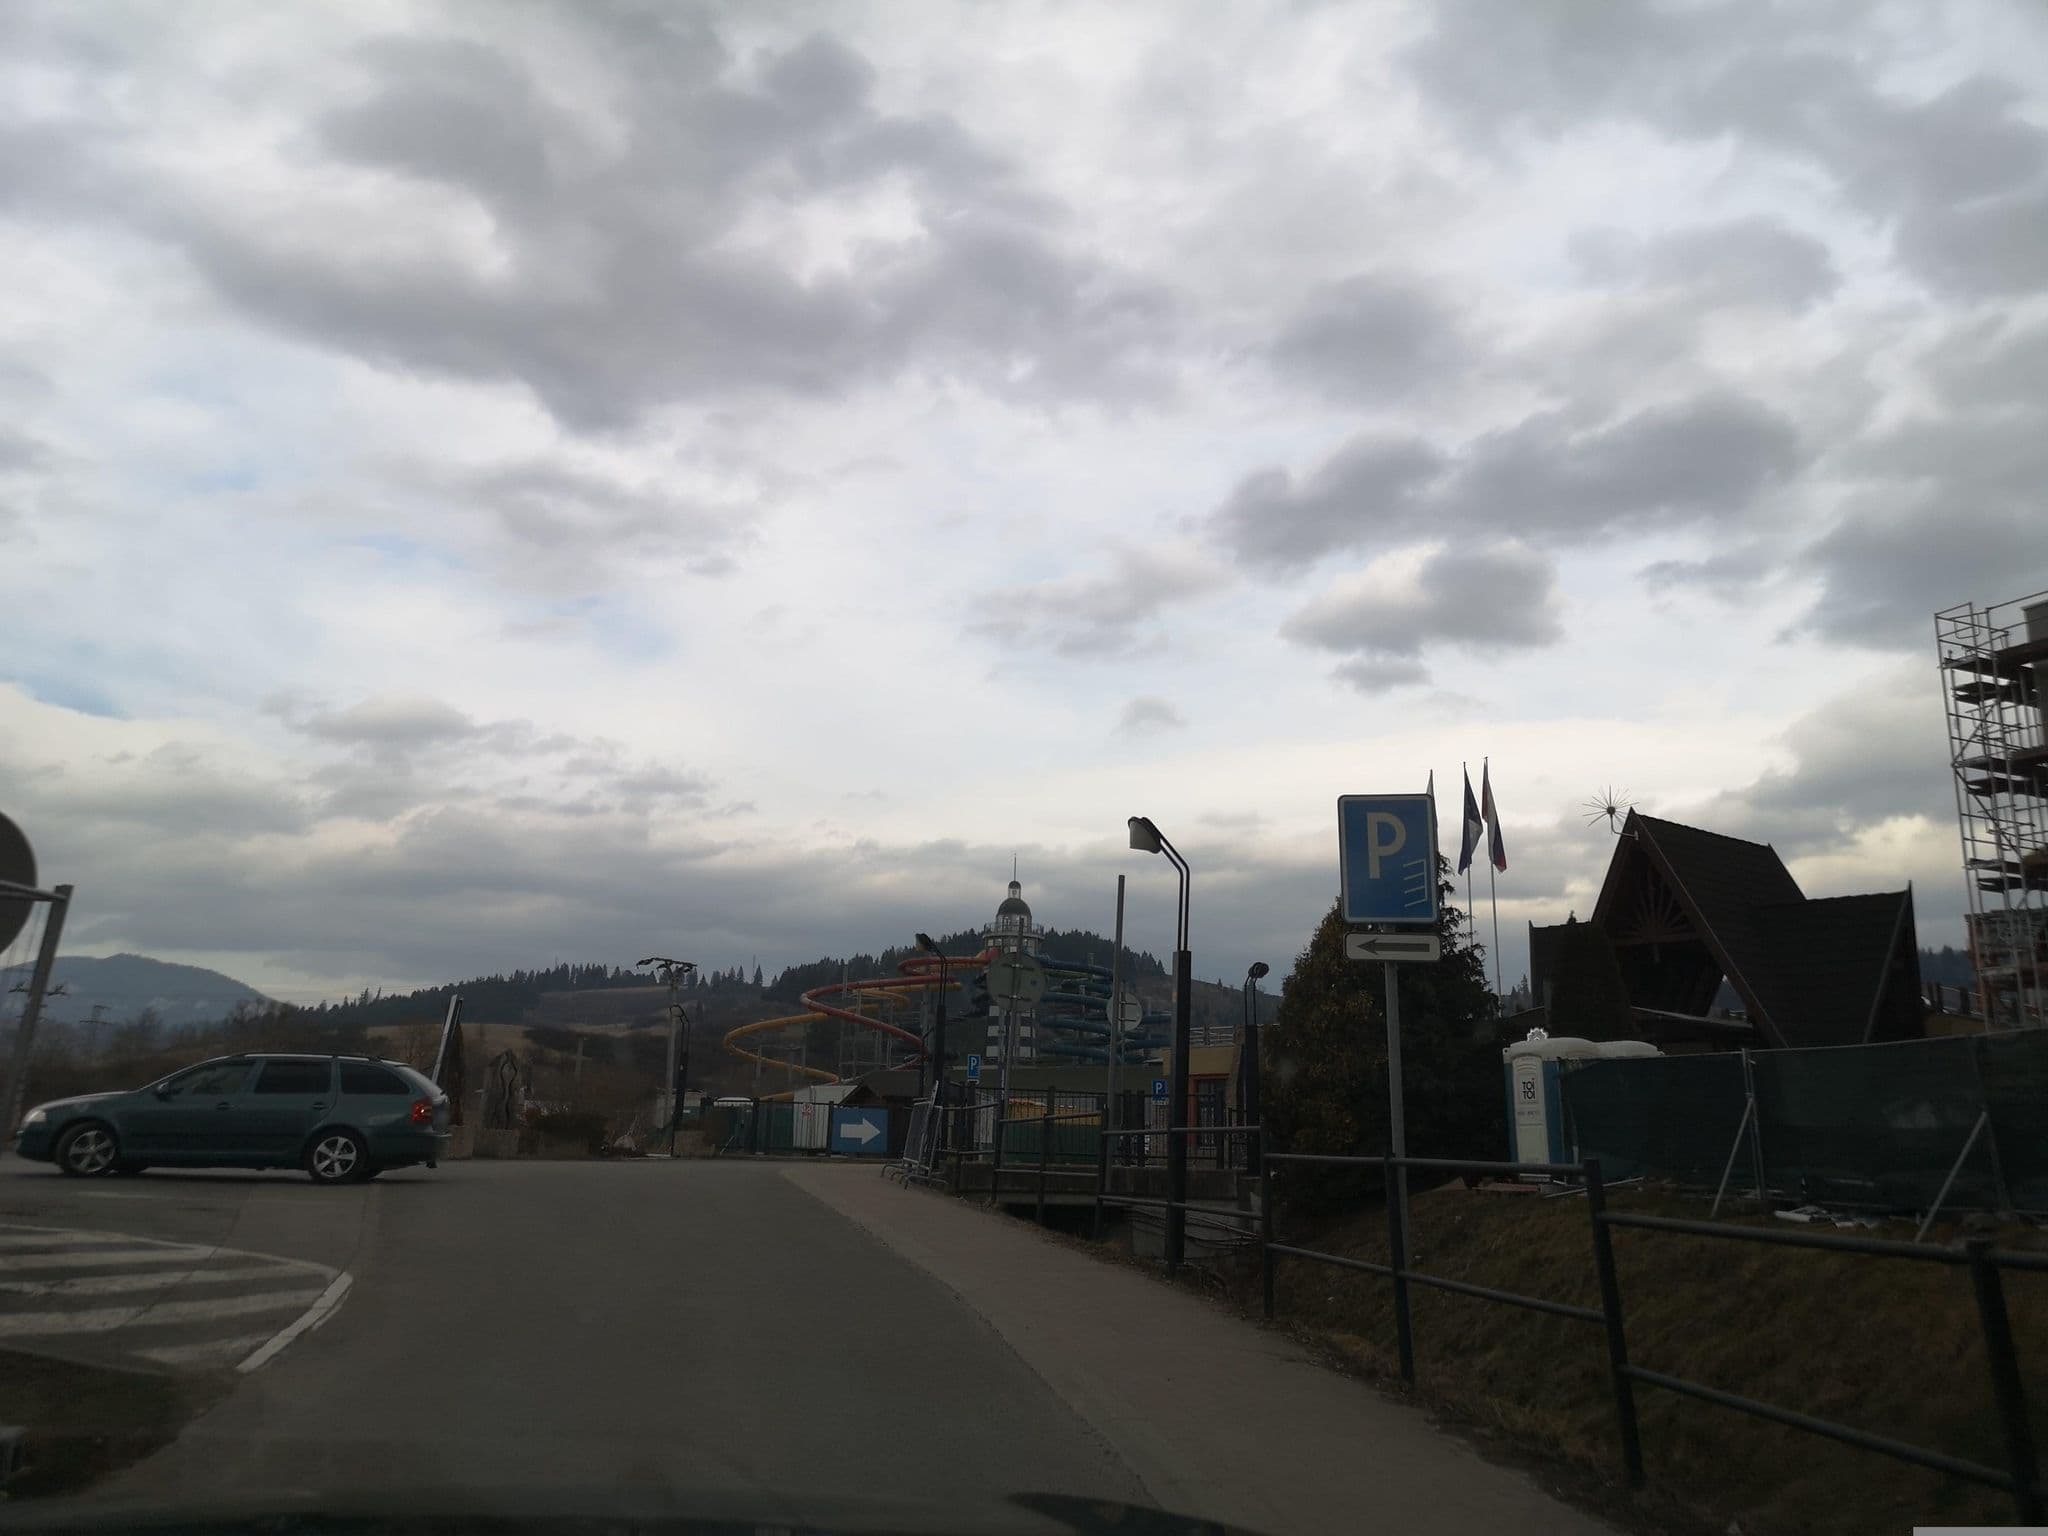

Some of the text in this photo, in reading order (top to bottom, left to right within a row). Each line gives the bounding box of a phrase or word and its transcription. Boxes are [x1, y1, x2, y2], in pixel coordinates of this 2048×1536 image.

[1366, 811, 1406, 880] P
[970, 1056, 977, 1070] P
[1155, 1081, 1163, 1094] P
